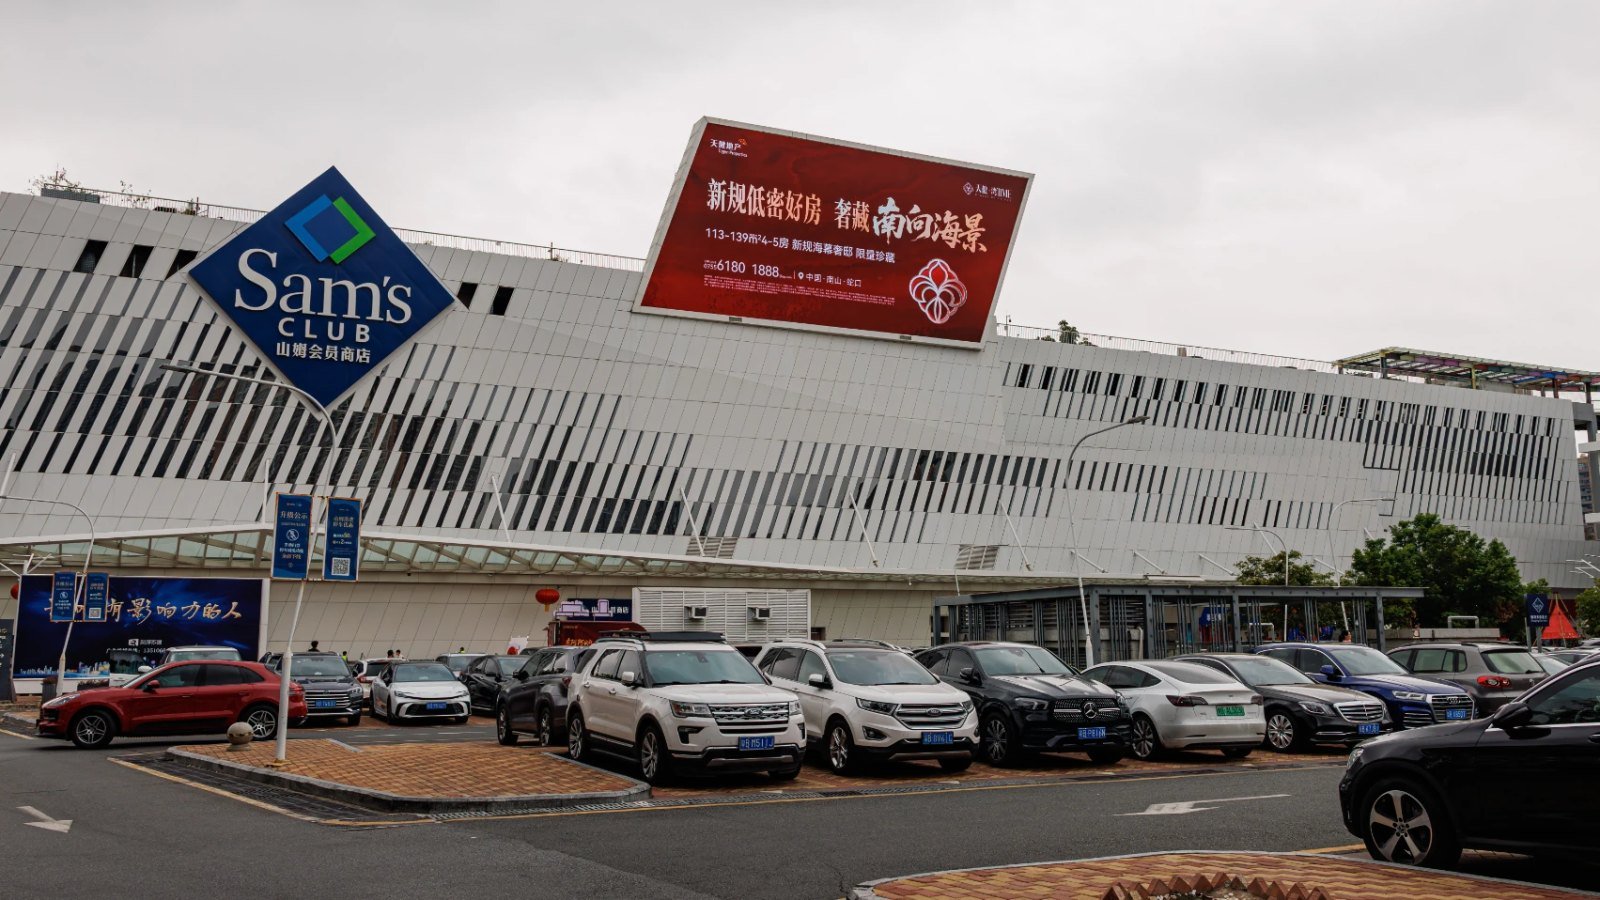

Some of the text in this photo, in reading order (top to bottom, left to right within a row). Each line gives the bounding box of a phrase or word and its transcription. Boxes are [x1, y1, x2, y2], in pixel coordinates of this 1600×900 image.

[707, 178, 821, 225] 新规低密好房
[855, 247, 895, 263] 限量珍藏
[717, 260, 746, 274] 6180
[752, 263, 779, 278] 1888
[234, 248, 412, 324] Sam's
[278, 317, 370, 343] CLUB
[276, 341, 371, 364] 山姆会员商店
